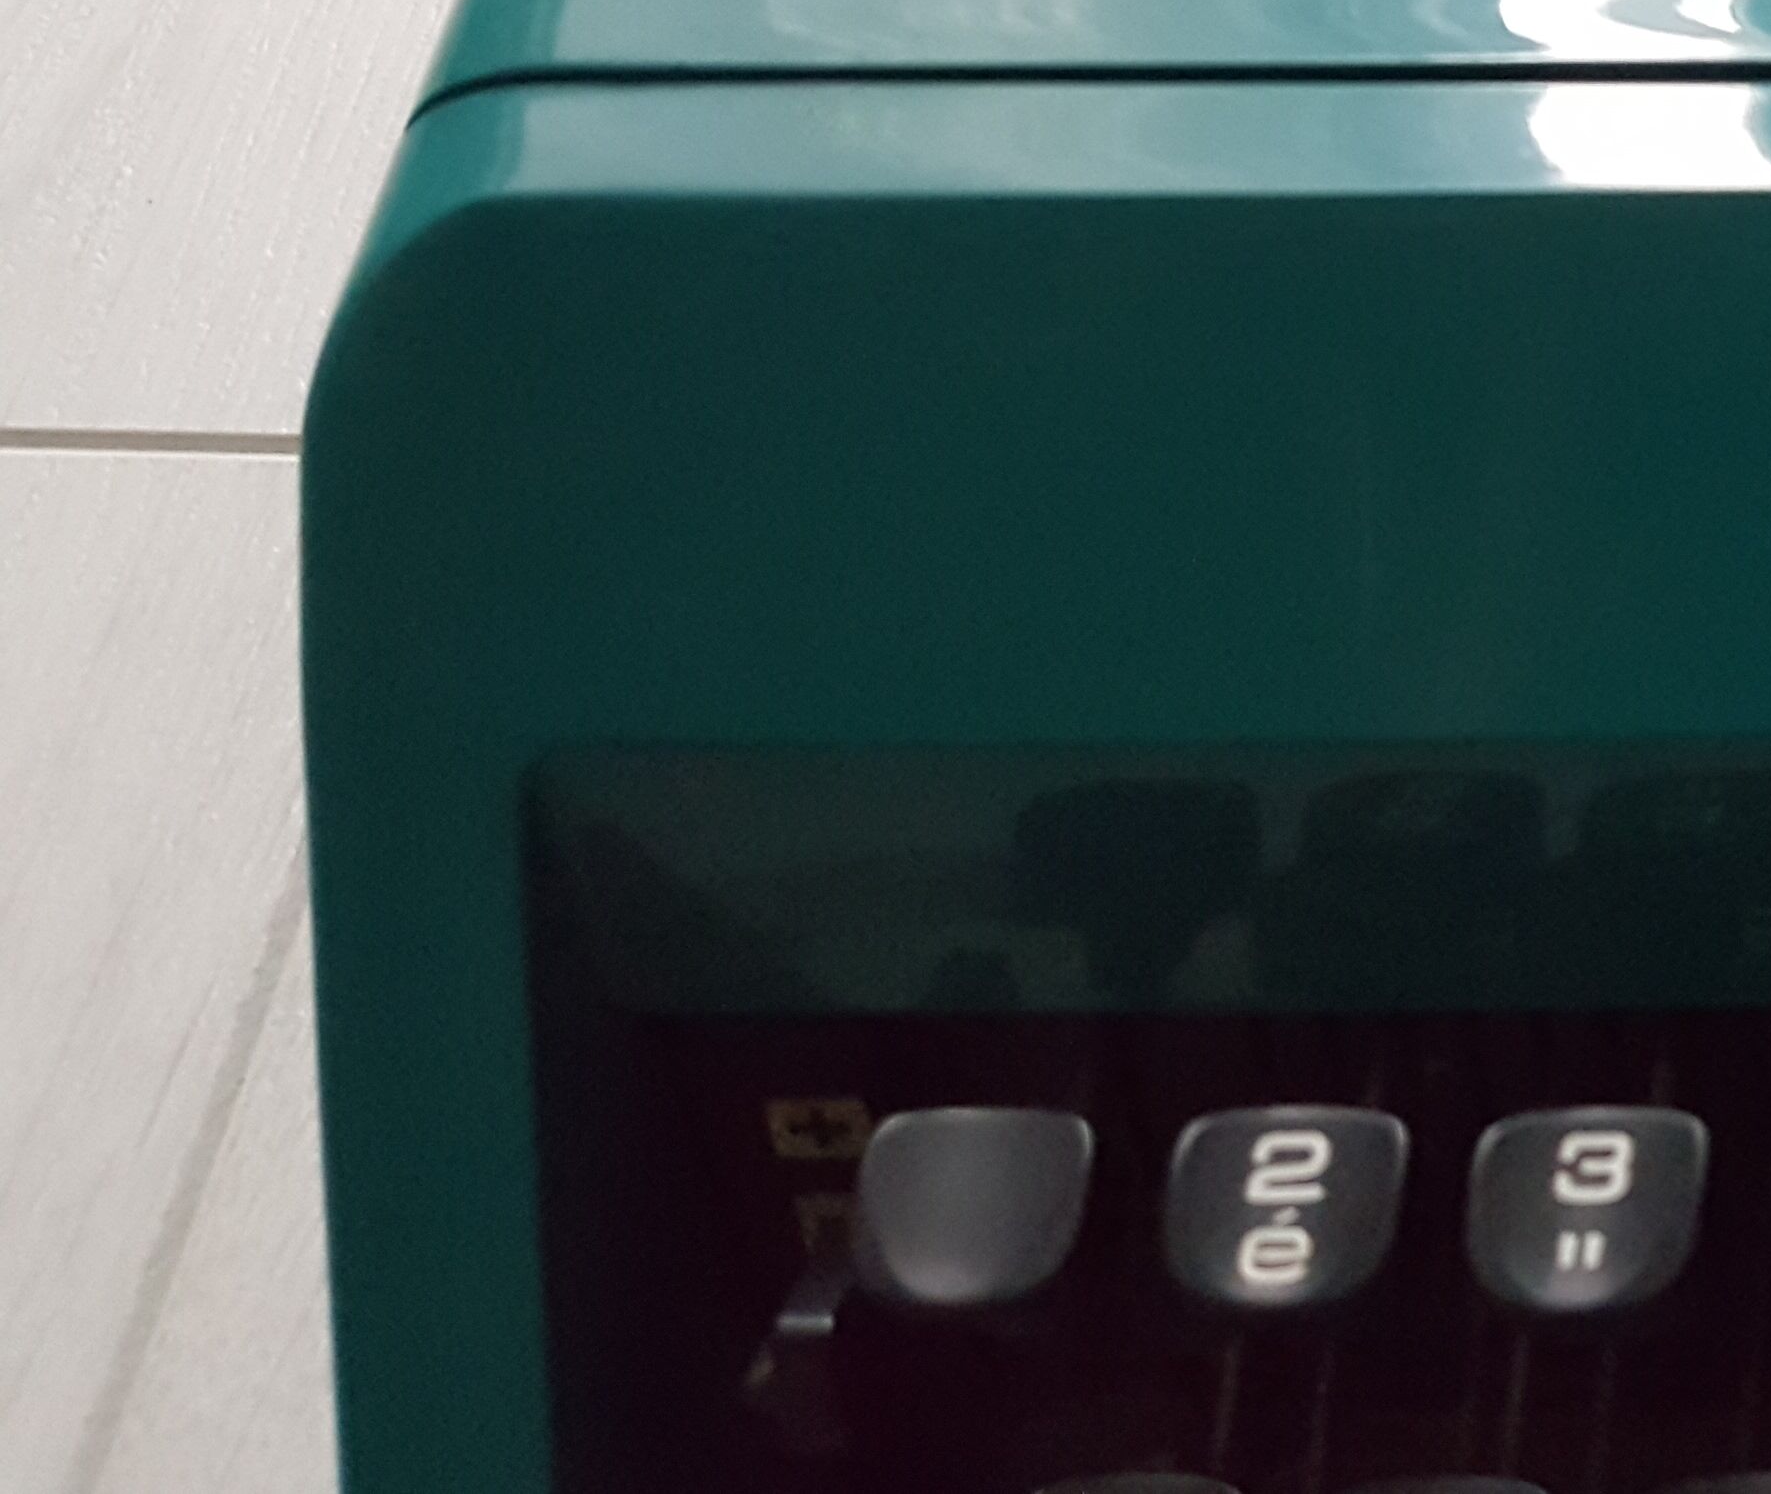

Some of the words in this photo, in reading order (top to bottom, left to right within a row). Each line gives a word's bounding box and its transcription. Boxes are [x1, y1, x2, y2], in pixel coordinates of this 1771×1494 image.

[1244, 1130, 1331, 1205] 2
[1553, 1131, 1634, 1206] 3
[1236, 1205, 1313, 1296] é
